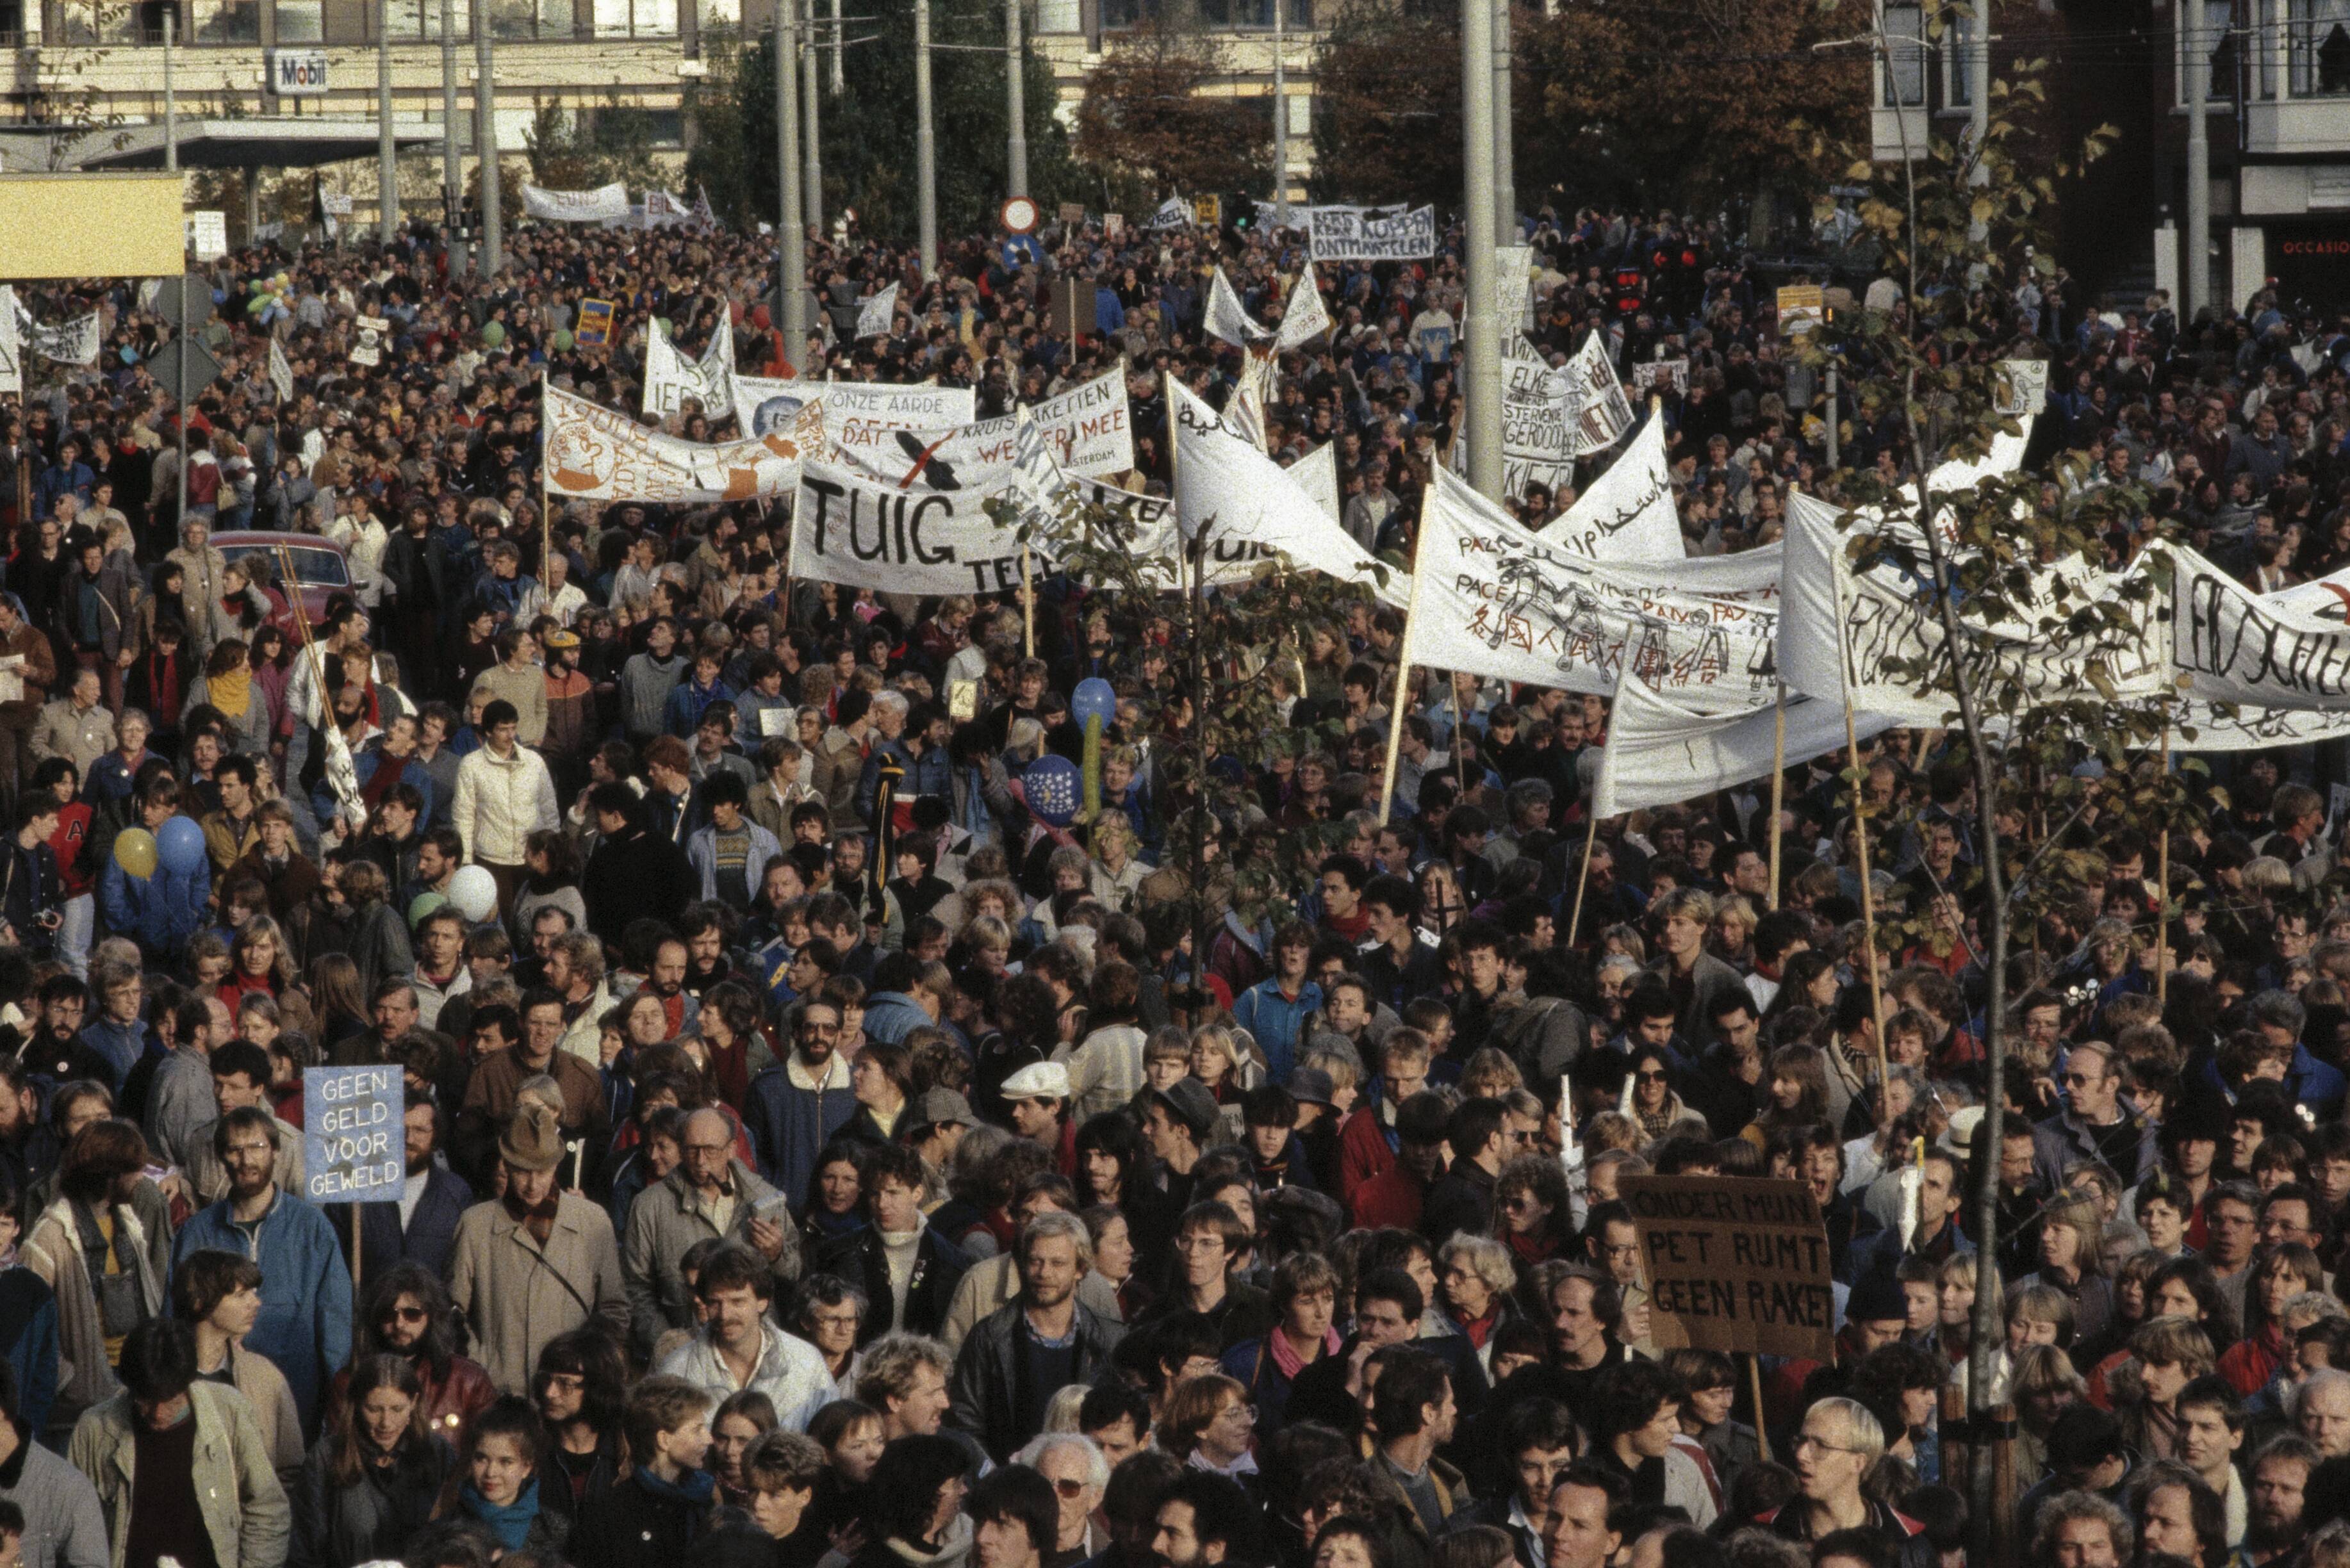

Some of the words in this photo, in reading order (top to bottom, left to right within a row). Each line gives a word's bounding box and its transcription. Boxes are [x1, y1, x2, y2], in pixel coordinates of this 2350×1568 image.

[282, 59, 326, 86] Mobil
[1510, 366, 1552, 396] ELKE
[832, 392, 879, 411] ONZE
[887, 397, 944, 414] AARDE
[1081, 409, 1125, 441] MEE
[801, 475, 956, 565] TUIG
[1455, 573, 1509, 603] PACE
[66, 819, 85, 842] A
[322, 1070, 388, 1101] GEEN
[322, 1102, 388, 1132] GELD
[324, 1132, 388, 1163] VOOR
[309, 1161, 400, 1196] GEWELD
[1633, 1189, 1738, 1221] ONDER
[1647, 1230, 1714, 1266] PET
[1652, 1278, 1737, 1321] GEEN
[1747, 1280, 1834, 1331] RAKET
